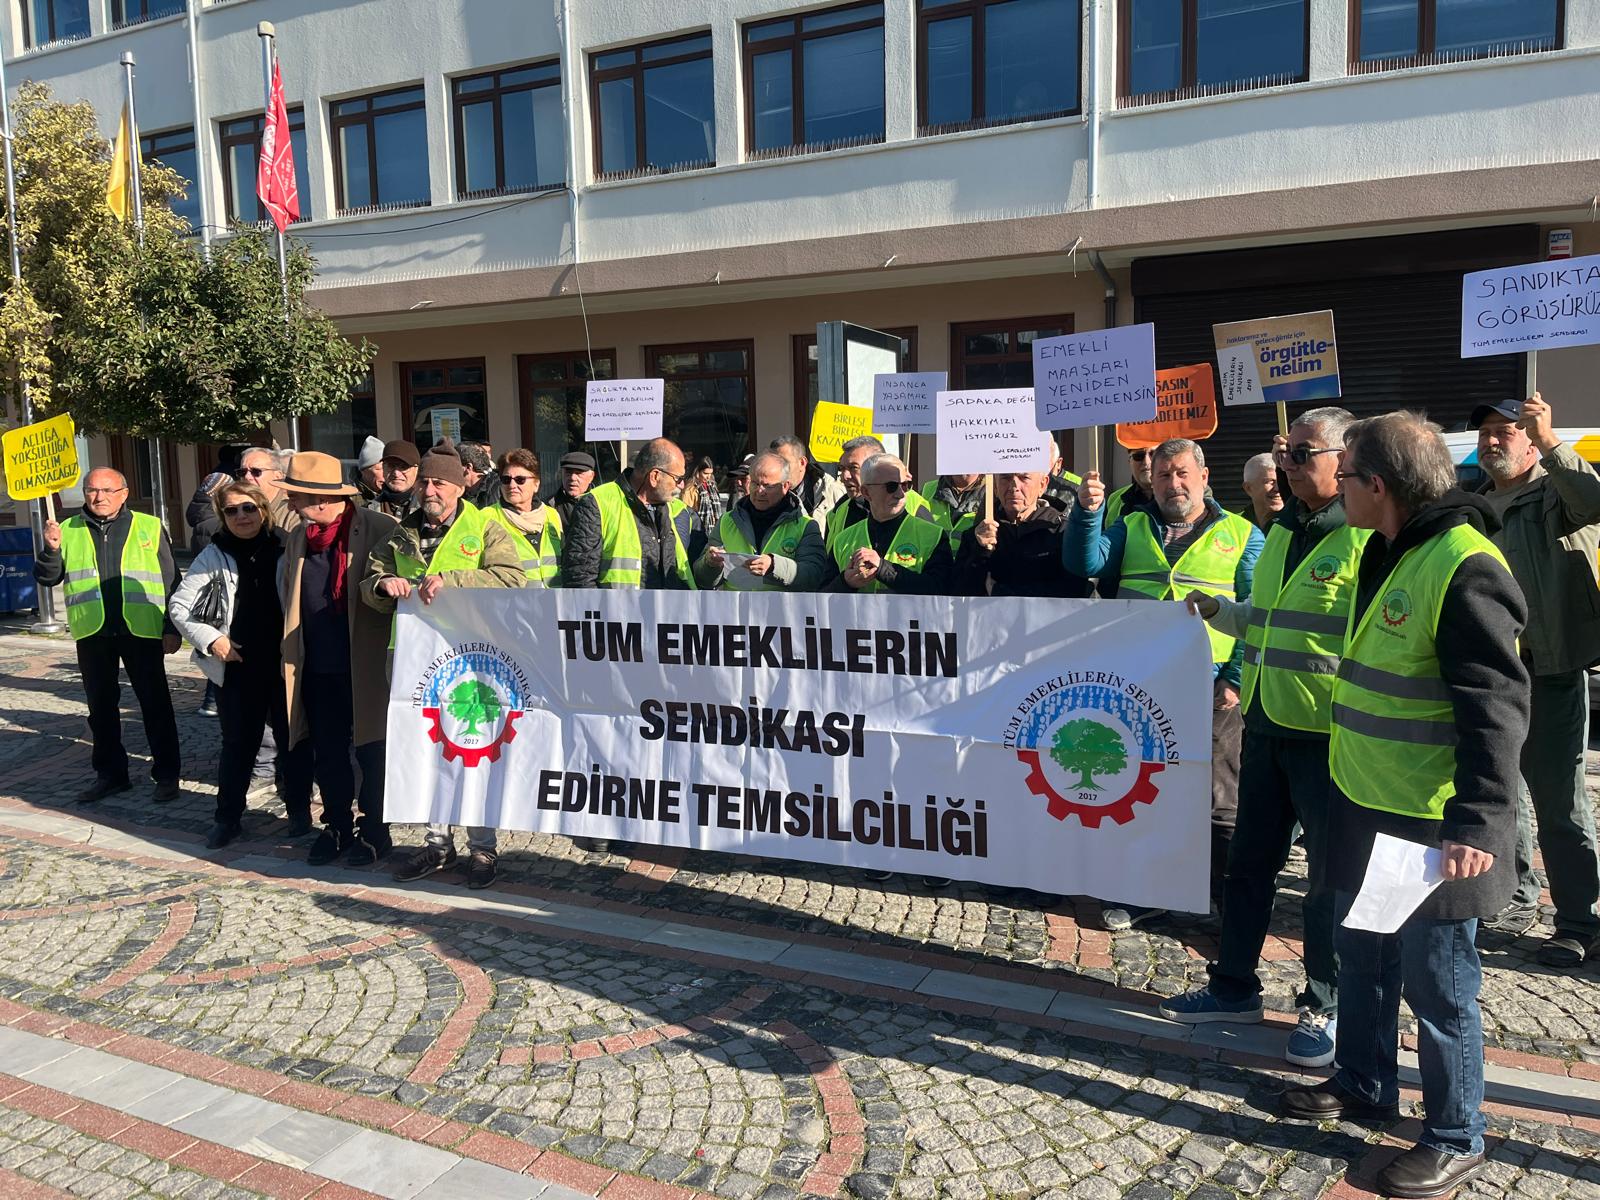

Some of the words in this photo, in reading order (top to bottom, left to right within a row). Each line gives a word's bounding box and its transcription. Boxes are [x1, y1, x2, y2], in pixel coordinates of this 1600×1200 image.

[1477, 266, 1600, 298] SANDIKTA
[1040, 336, 1108, 359] EMEKLİ
[1048, 358, 1129, 380] MAAŞLARI
[1269, 358, 1322, 378] nelim
[1048, 374, 1129, 397] YENİDEN
[945, 398, 1003, 407] SADAKA
[1045, 385, 1156, 415] DÜZENLENSİN
[1157, 389, 1194, 407] GÜTLÜ
[950, 418, 1016, 428] HAKKIMIZI
[557, 610, 643, 663] TÜM
[656, 616, 958, 678] EMEKLİLERİN
[411, 681, 426, 708] TÜM
[423, 641, 498, 680] EMEKLİLERİN
[499, 650, 533, 712] SENDİKASI
[639, 696, 866, 758] SENDİKASI
[1003, 714, 1022, 750] TÜM
[1017, 670, 1126, 715] EMEKLİLERİN
[1124, 683, 1180, 766] SENDİKASI
[1078, 792, 1098, 801] 2017
[536, 763, 680, 823] EDİRNE
[691, 783, 988, 858] TEMSİLCİLİĞİ
